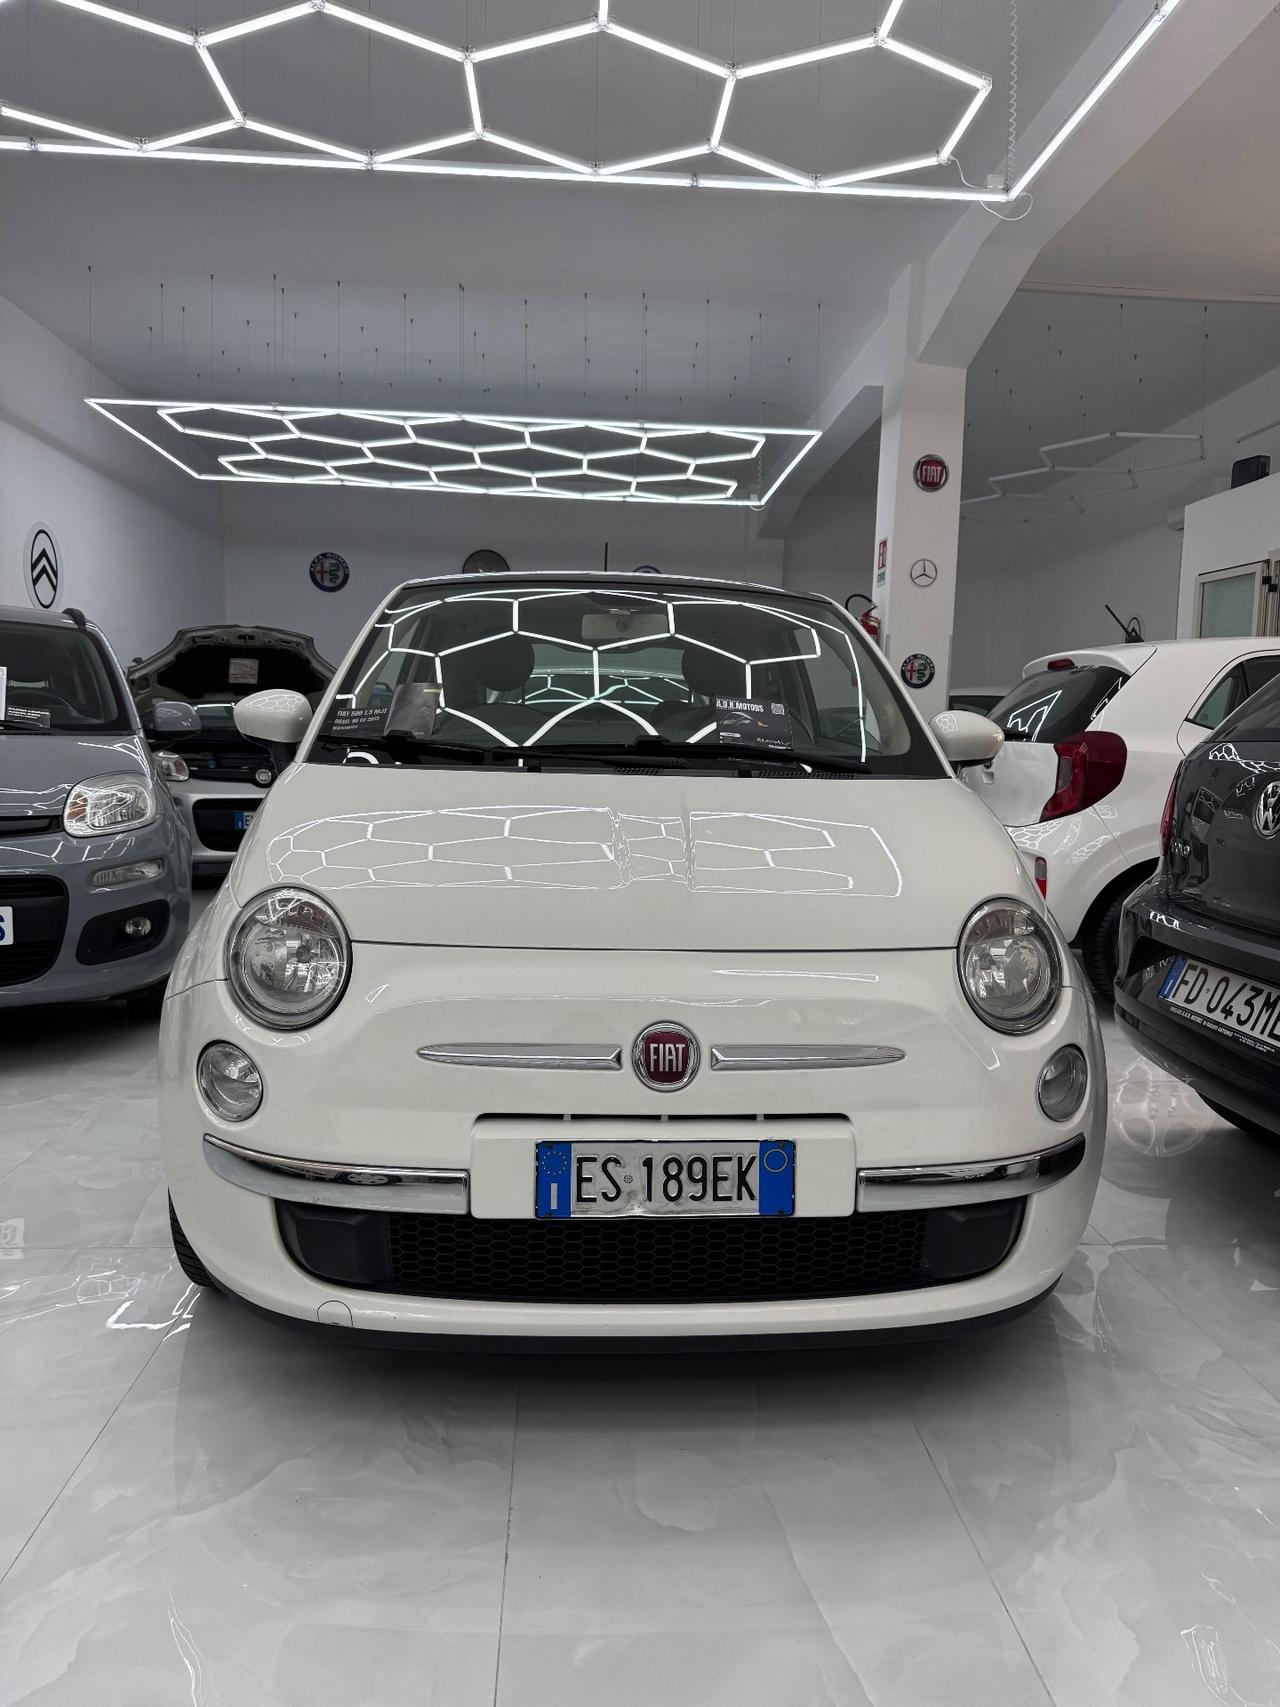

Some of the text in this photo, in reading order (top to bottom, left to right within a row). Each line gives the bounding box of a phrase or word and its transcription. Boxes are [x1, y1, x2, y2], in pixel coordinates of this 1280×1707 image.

[922, 465, 942, 482] FIAT
[1172, 964, 1208, 1004] FD
[650, 1043, 686, 1072] FIAT
[576, 1155, 757, 1202] ES 189EK
